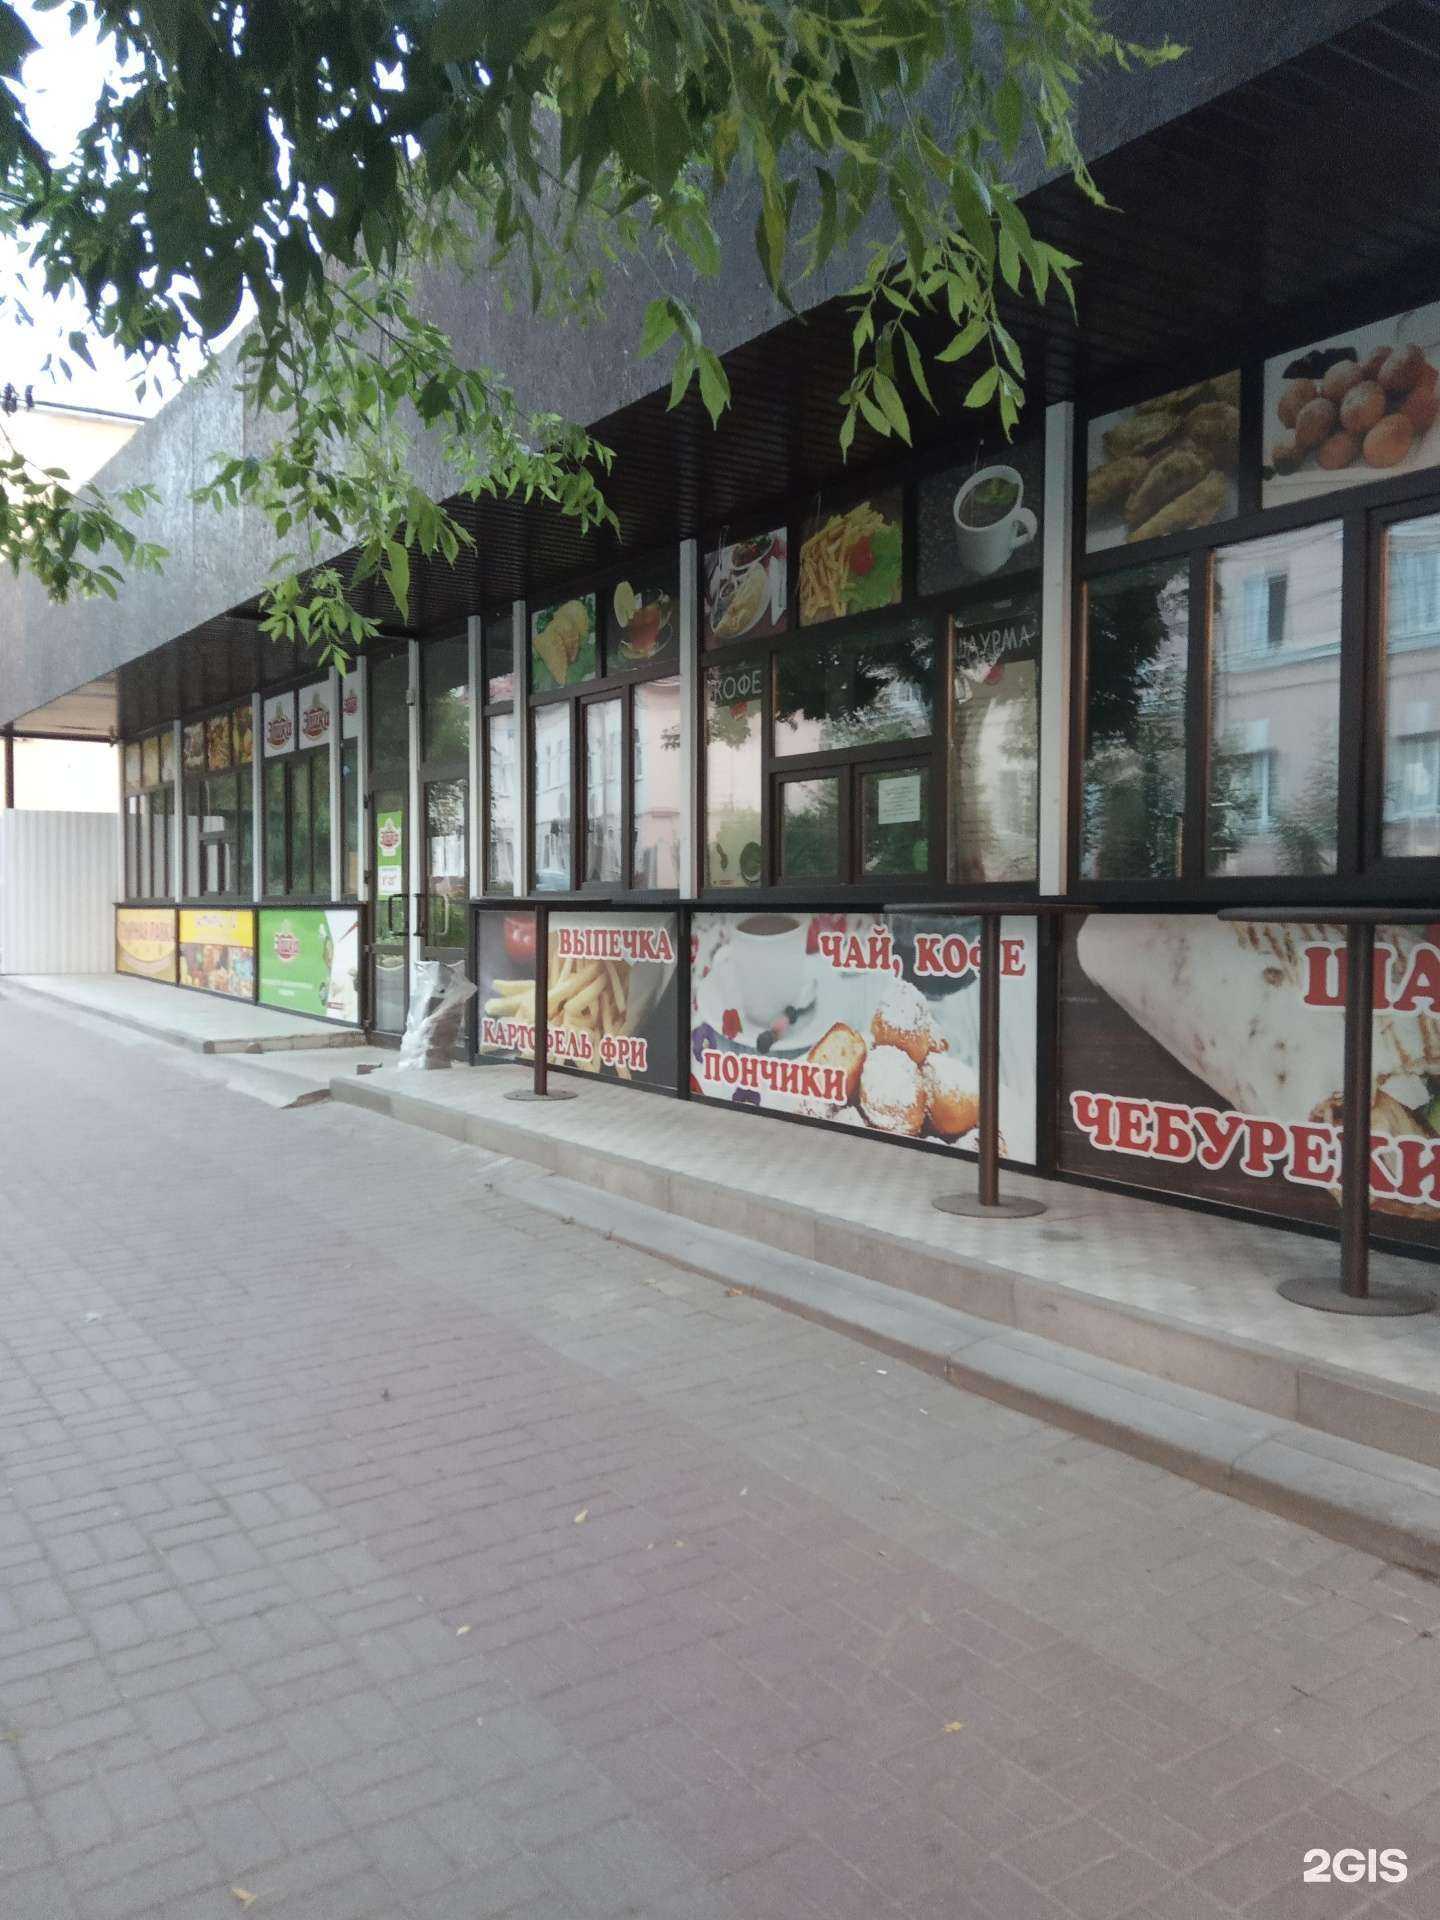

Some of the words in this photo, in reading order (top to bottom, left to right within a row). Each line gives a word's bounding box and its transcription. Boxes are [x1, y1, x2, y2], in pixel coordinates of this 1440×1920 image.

[558, 927, 674, 961] ВЫПЕЧКА
[819, 927, 901, 978] ЧАЙ,
[600, 1036, 647, 1068] ФРИ
[703, 1052, 846, 1101] ПОНЧИКИ
